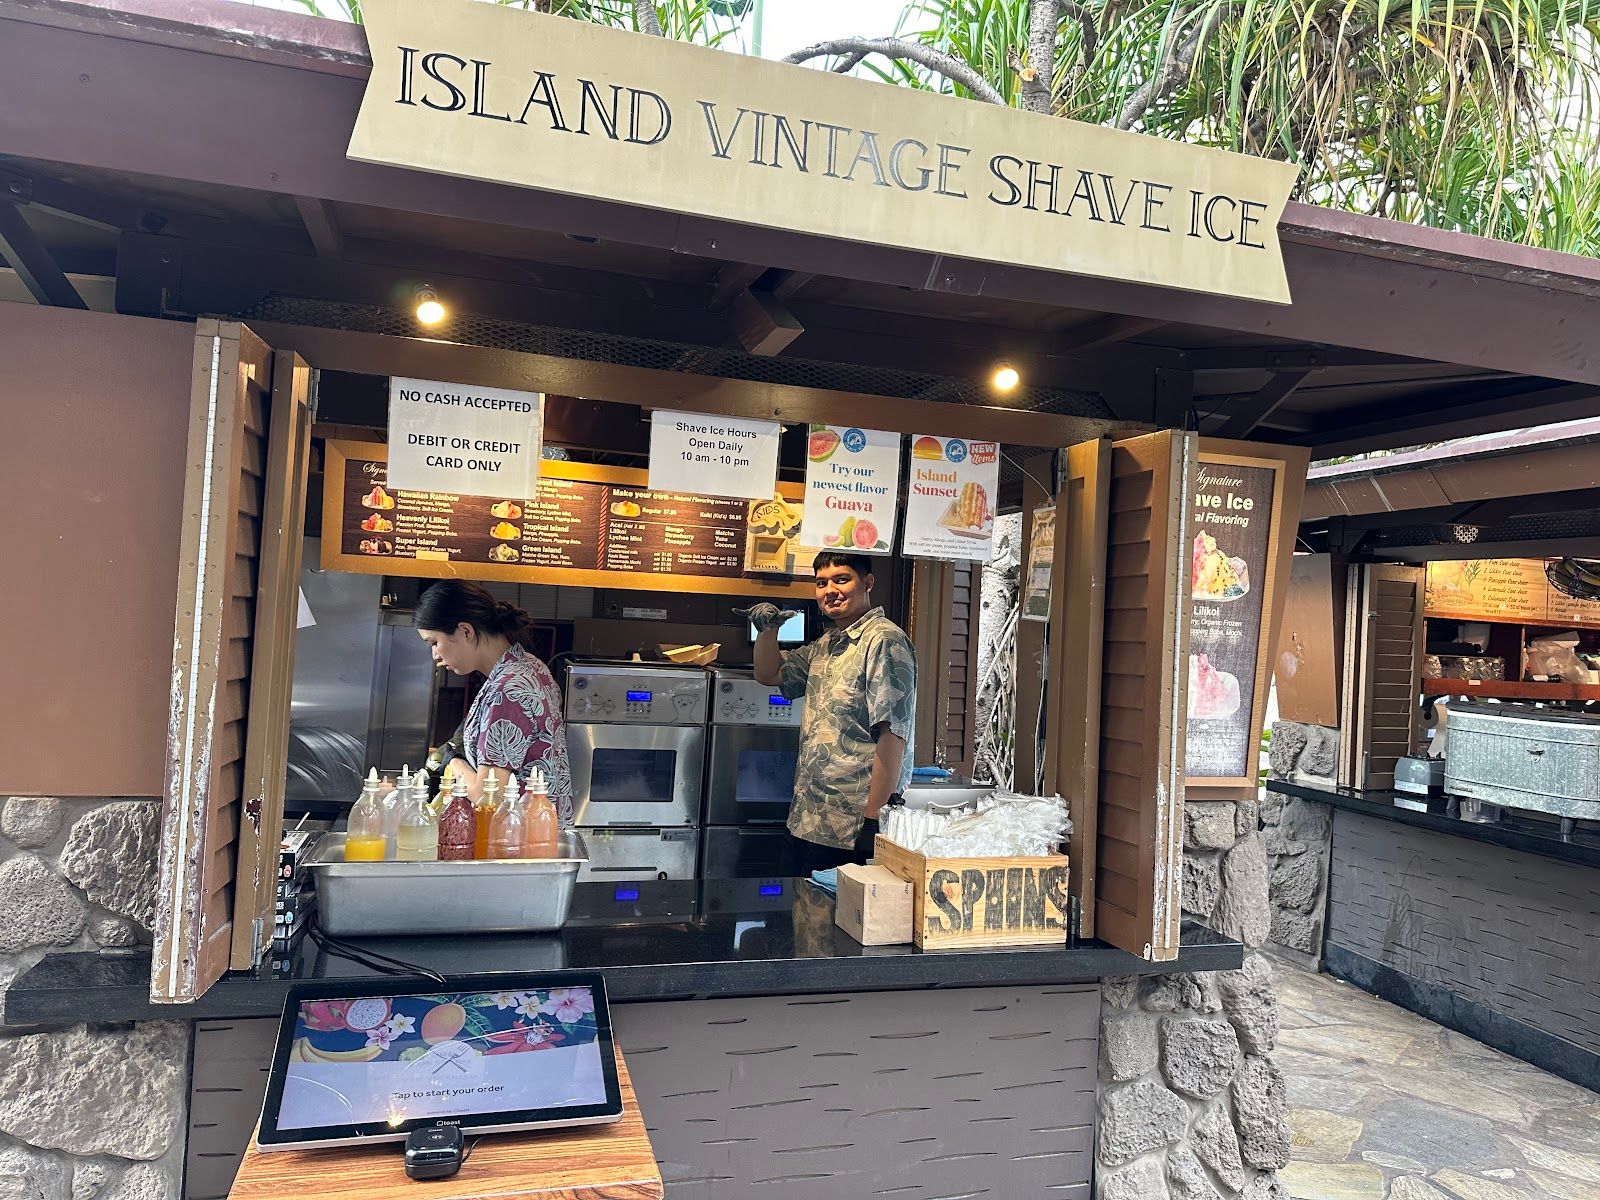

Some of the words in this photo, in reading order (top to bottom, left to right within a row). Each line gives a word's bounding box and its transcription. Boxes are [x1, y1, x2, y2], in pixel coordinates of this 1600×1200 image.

[395, 46, 672, 146] ISLAND
[696, 100, 971, 198] VINTAGE
[988, 155, 1173, 233] SHAVE
[1187, 190, 1268, 249] ICE
[400, 389, 421, 402] NO
[425, 392, 461, 406] CASH
[465, 396, 531, 413] ACCEPTED
[676, 422, 707, 434] Shave
[710, 425, 725, 436] Ice
[727, 428, 757, 439] Hours
[408, 433, 448, 447] DEBIT
[451, 438, 470, 450] OR
[474, 440, 521, 454] CREDIT
[689, 438, 715, 449] Open
[718, 441, 743, 453] Daily
[971, 444, 995, 454] NEW
[426, 455, 463, 469] CARD
[467, 459, 502, 472] ONLY
[681, 451, 692, 461] 10
[695, 454, 710, 463] am
[720, 455, 731, 465] 10
[734, 458, 749, 467] pm
[830, 463, 852, 477] Try
[853, 467, 875, 477] our
[916, 468, 957, 483] Island
[813, 480, 853, 492] newest
[855, 482, 888, 495] flavor
[913, 483, 958, 498] Sunset
[398, 491, 429, 500] Hawaiian
[430, 492, 459, 501] Rainbow
[613, 489, 633, 498] Make
[635, 491, 652, 499] your
[692, 496, 715, 505] Flavoring
[1226, 492, 1254, 511] Ice
[524, 500, 539, 508] Pink
[642, 507, 662, 515] Regular
[825, 496, 873, 513] Guava
[396, 514, 428, 523] Heavenly
[429, 516, 450, 524] Lilikoi
[756, 505, 780, 519] KIDS
[523, 522, 549, 531] Tropical
[1205, 512, 1249, 528] Flavoring
[395, 537, 416, 545] Super
[417, 538, 438, 546] Island
[609, 533, 629, 541] Lychee
[664, 538, 691, 546] Pineapple
[665, 532, 694, 540] Strawberry
[1194, 606, 1220, 616] Lilikoi
[391, 1092, 411, 1100] Tap
[426, 1089, 451, 1097] start
[452, 1087, 475, 1097] your
[477, 1085, 505, 1093] order
